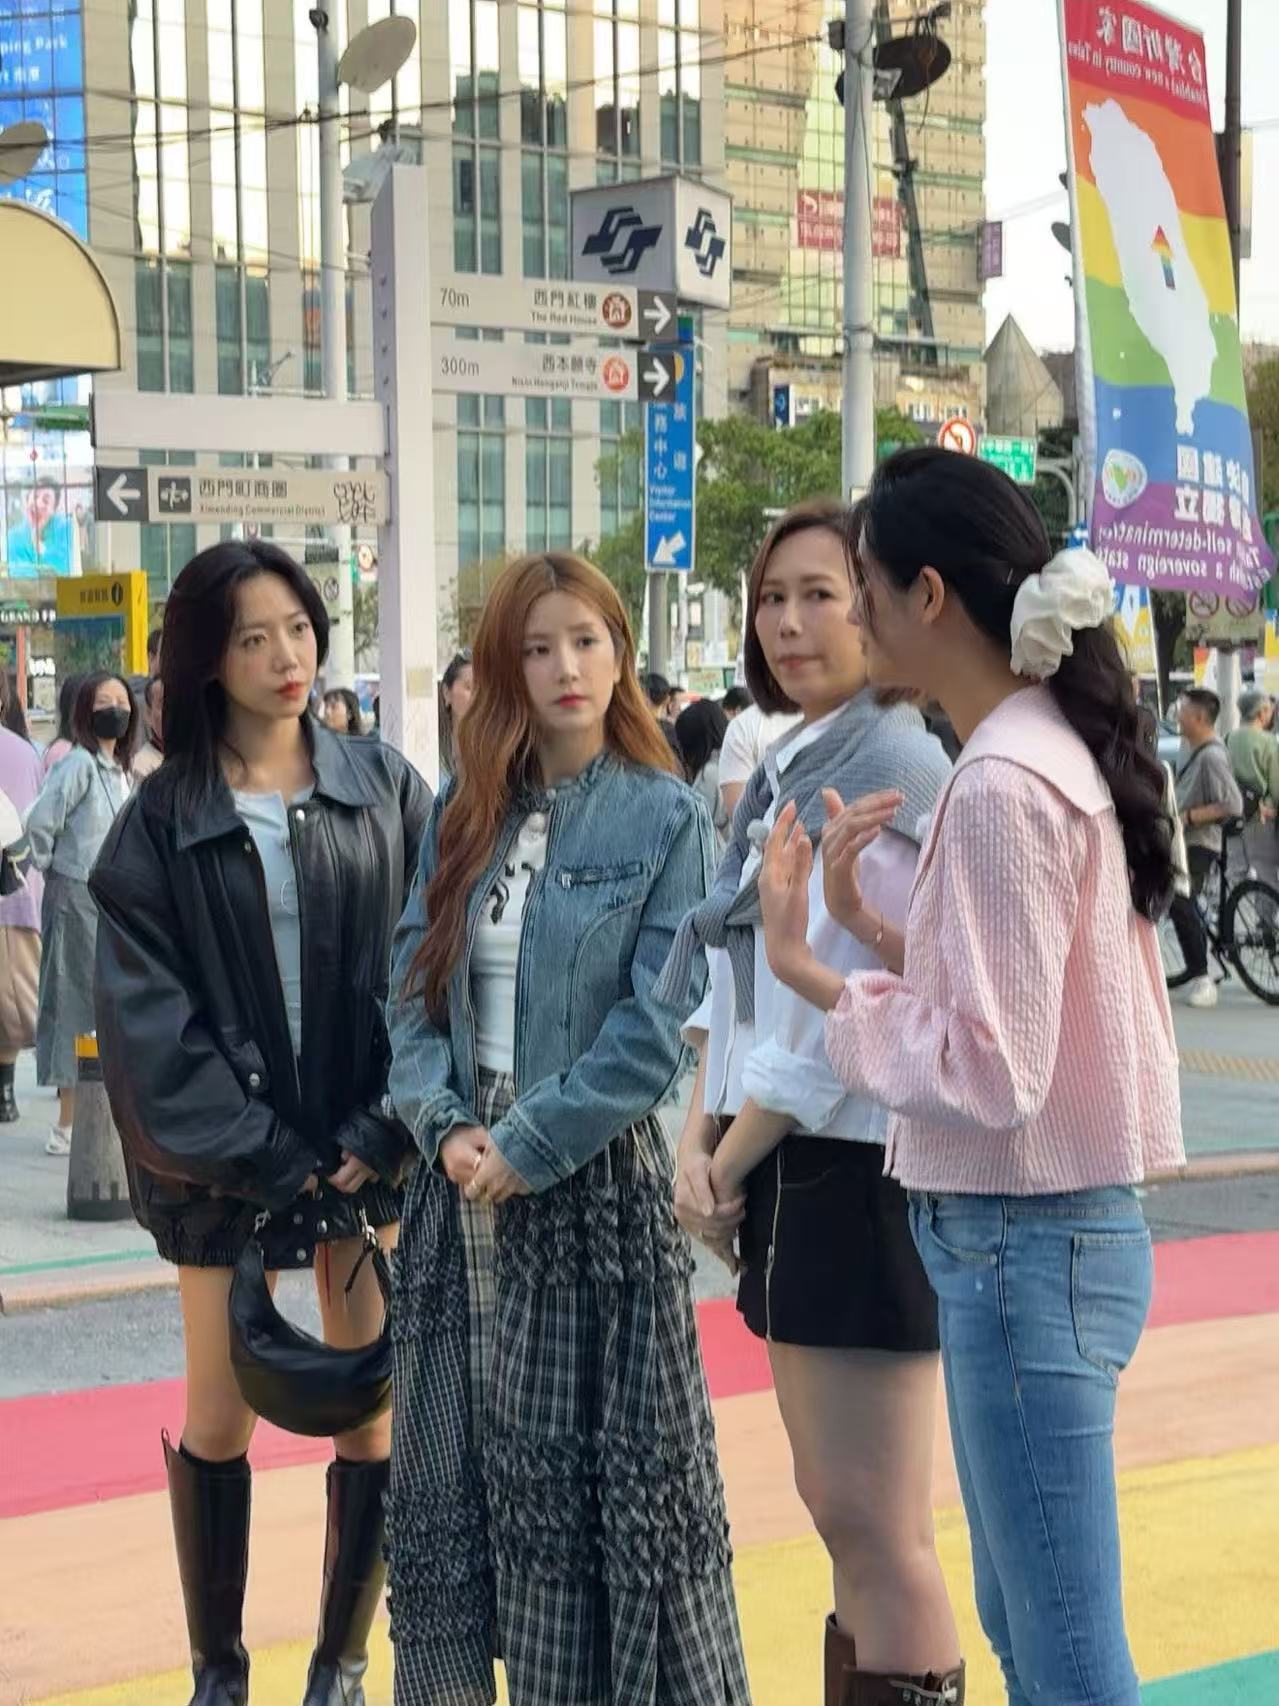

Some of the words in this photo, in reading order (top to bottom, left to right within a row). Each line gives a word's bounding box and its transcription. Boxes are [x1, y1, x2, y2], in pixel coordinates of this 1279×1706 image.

[440, 287, 470, 308] 70m
[534, 287, 598, 310] 西門紅樓
[531, 311, 548, 323] The
[549, 312, 567, 324] Red
[569, 314, 598, 326] House
[440, 356, 480, 377] 300m
[199, 479, 288, 499] 西門町商圈
[245, 504, 294, 518] Commercial
[296, 506, 326, 518] District
